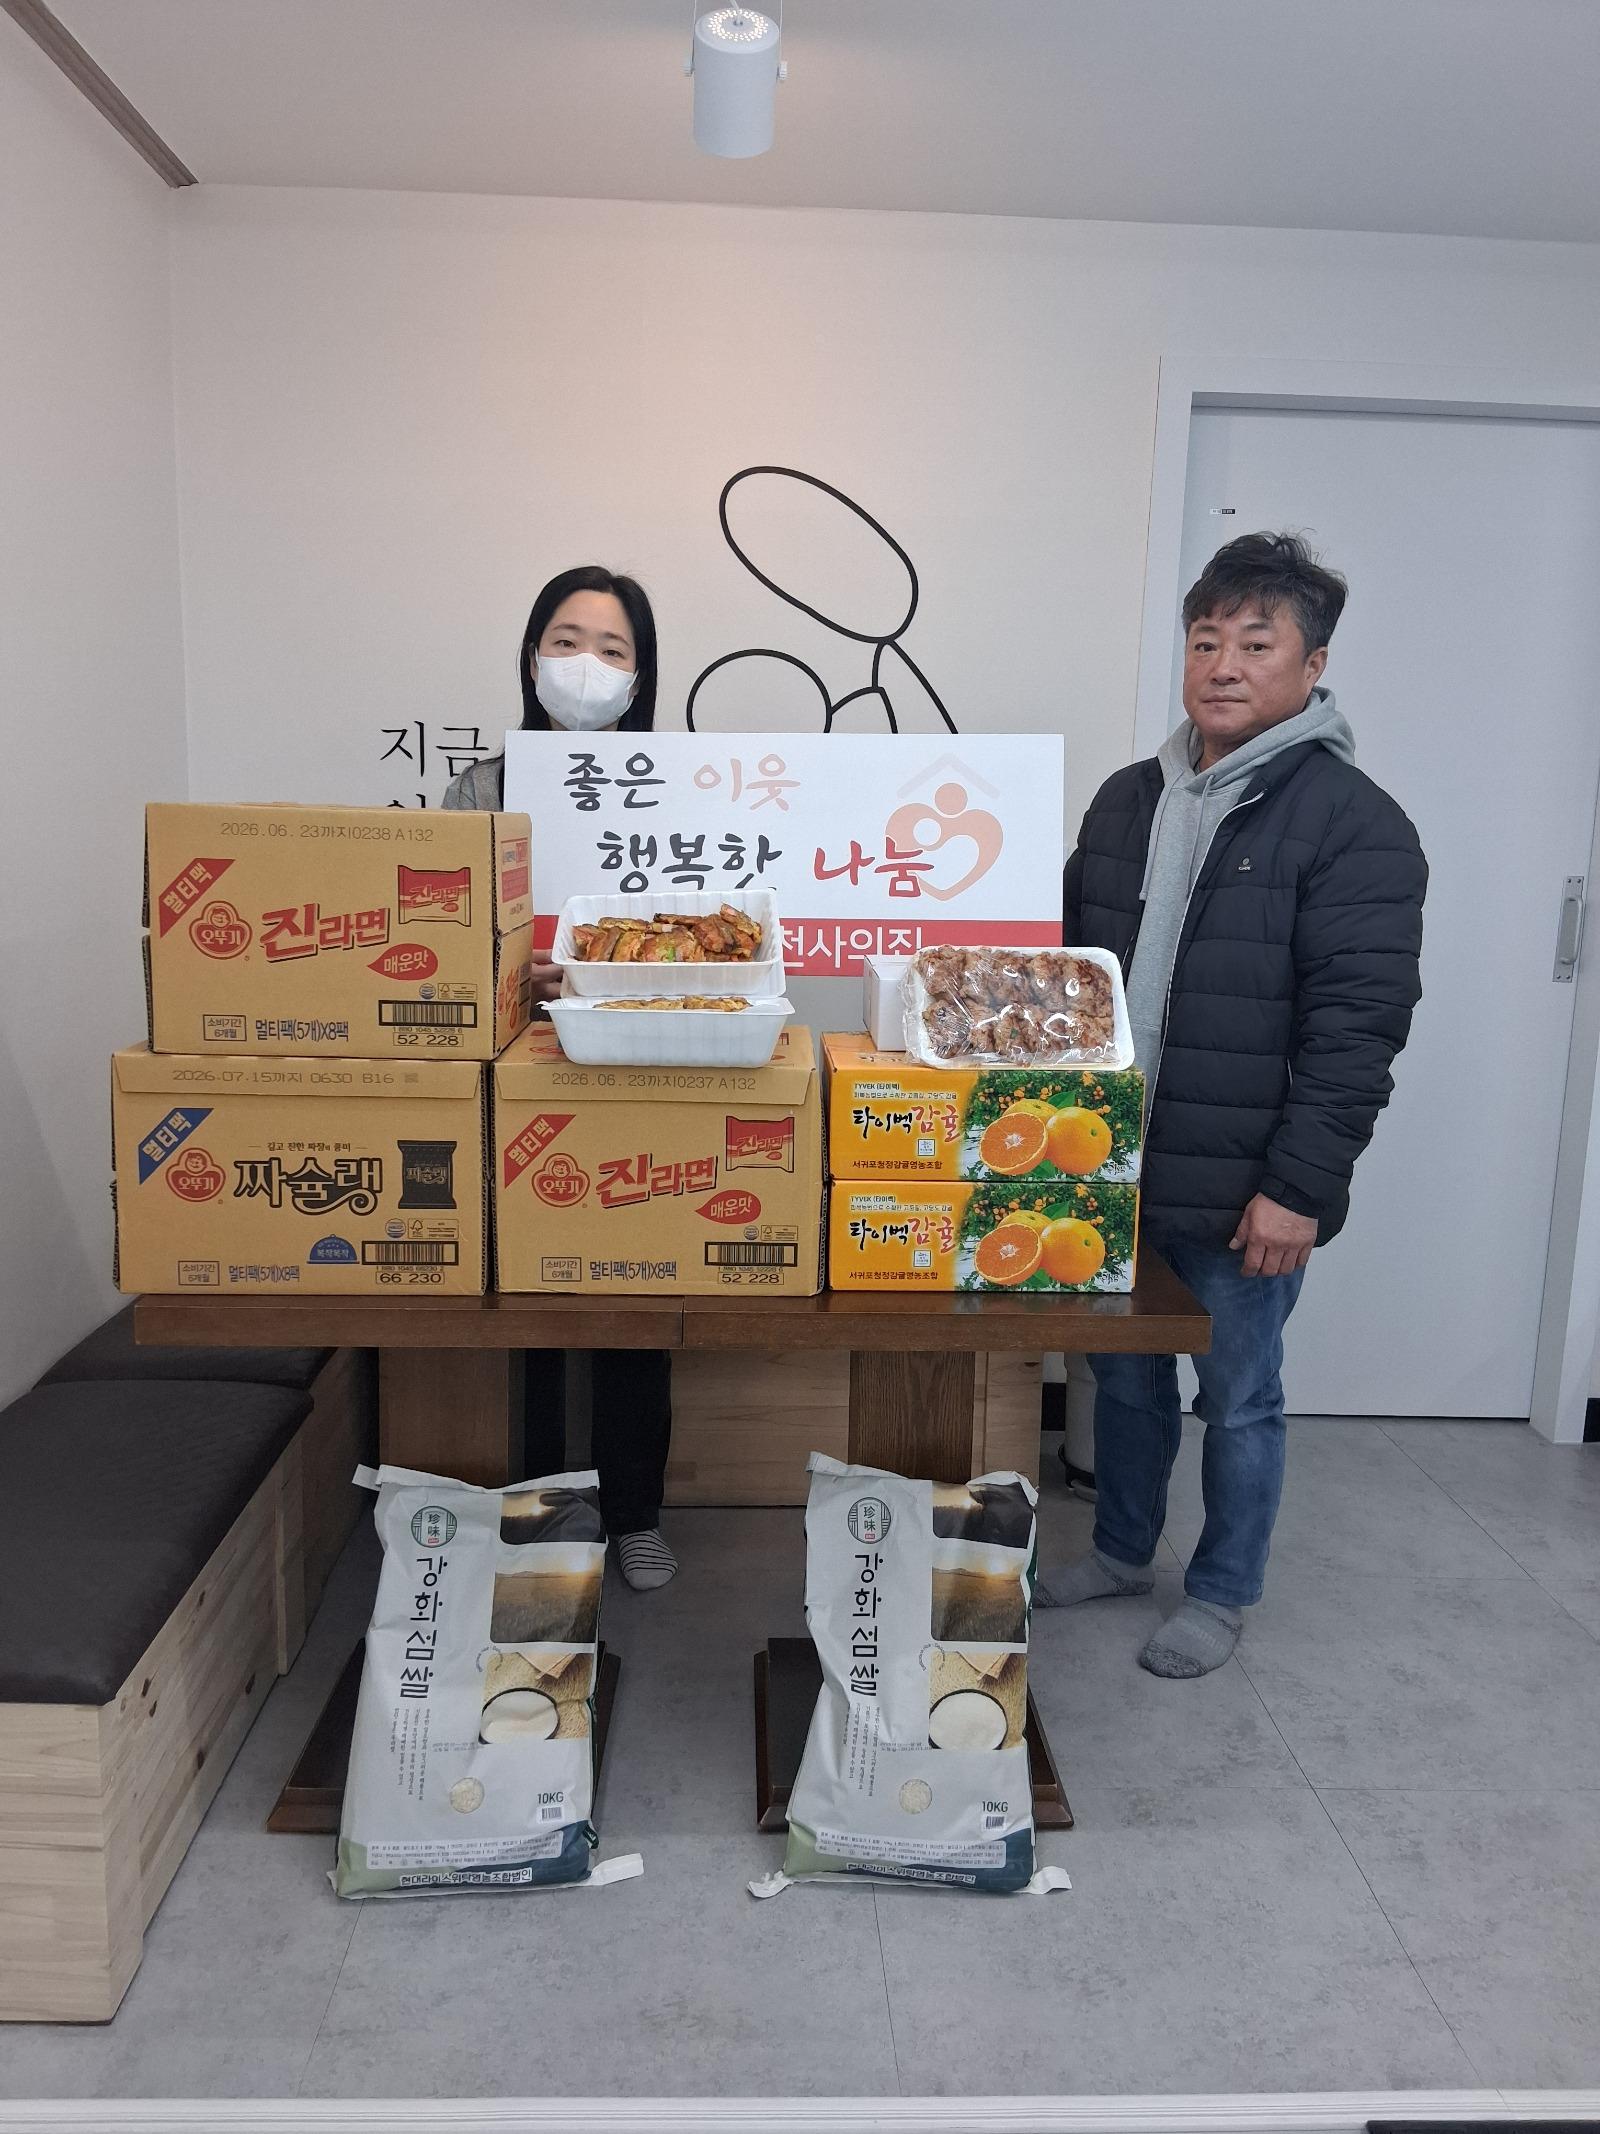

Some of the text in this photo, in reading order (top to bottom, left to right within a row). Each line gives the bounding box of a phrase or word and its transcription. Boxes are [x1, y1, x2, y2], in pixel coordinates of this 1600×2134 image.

[380, 720, 489, 778] 지금
[563, 752, 802, 812] 좋은 이웃
[814, 836, 936, 898] 나눔
[162, 862, 214, 914] 멀티팩
[200, 929, 242, 945] 오뚜기
[259, 902, 391, 964] 진라면
[383, 949, 430, 974] 매운맛
[207, 1017, 242, 1028] 소비기간
[397, 1034, 459, 1046] 52 228
[310, 1072, 353, 1084] 0630
[362, 1073, 394, 1084] B16
[142, 1111, 192, 1162] 멀티팩
[508, 1117, 556, 1167] 멀티팩
[179, 1176, 214, 1191] 오뚜기
[233, 1156, 383, 1216] 짜슐랭
[542, 1180, 580, 1194] 오뚜기
[595, 1152, 718, 1209] 진라면
[710, 1195, 753, 1219] 매운맛
[380, 1273, 442, 1283] 66 230
[721, 1273, 780, 1284] 52 228
[427, 1513, 440, 1537] 珍味
[863, 1505, 876, 1532] 珍味
[400, 1555, 448, 1699] 강화섬쌀
[849, 1552, 884, 1697] 강화섬쌀
[537, 1791, 564, 1804] 10KG
[982, 1801, 1009, 1812] 10KG
